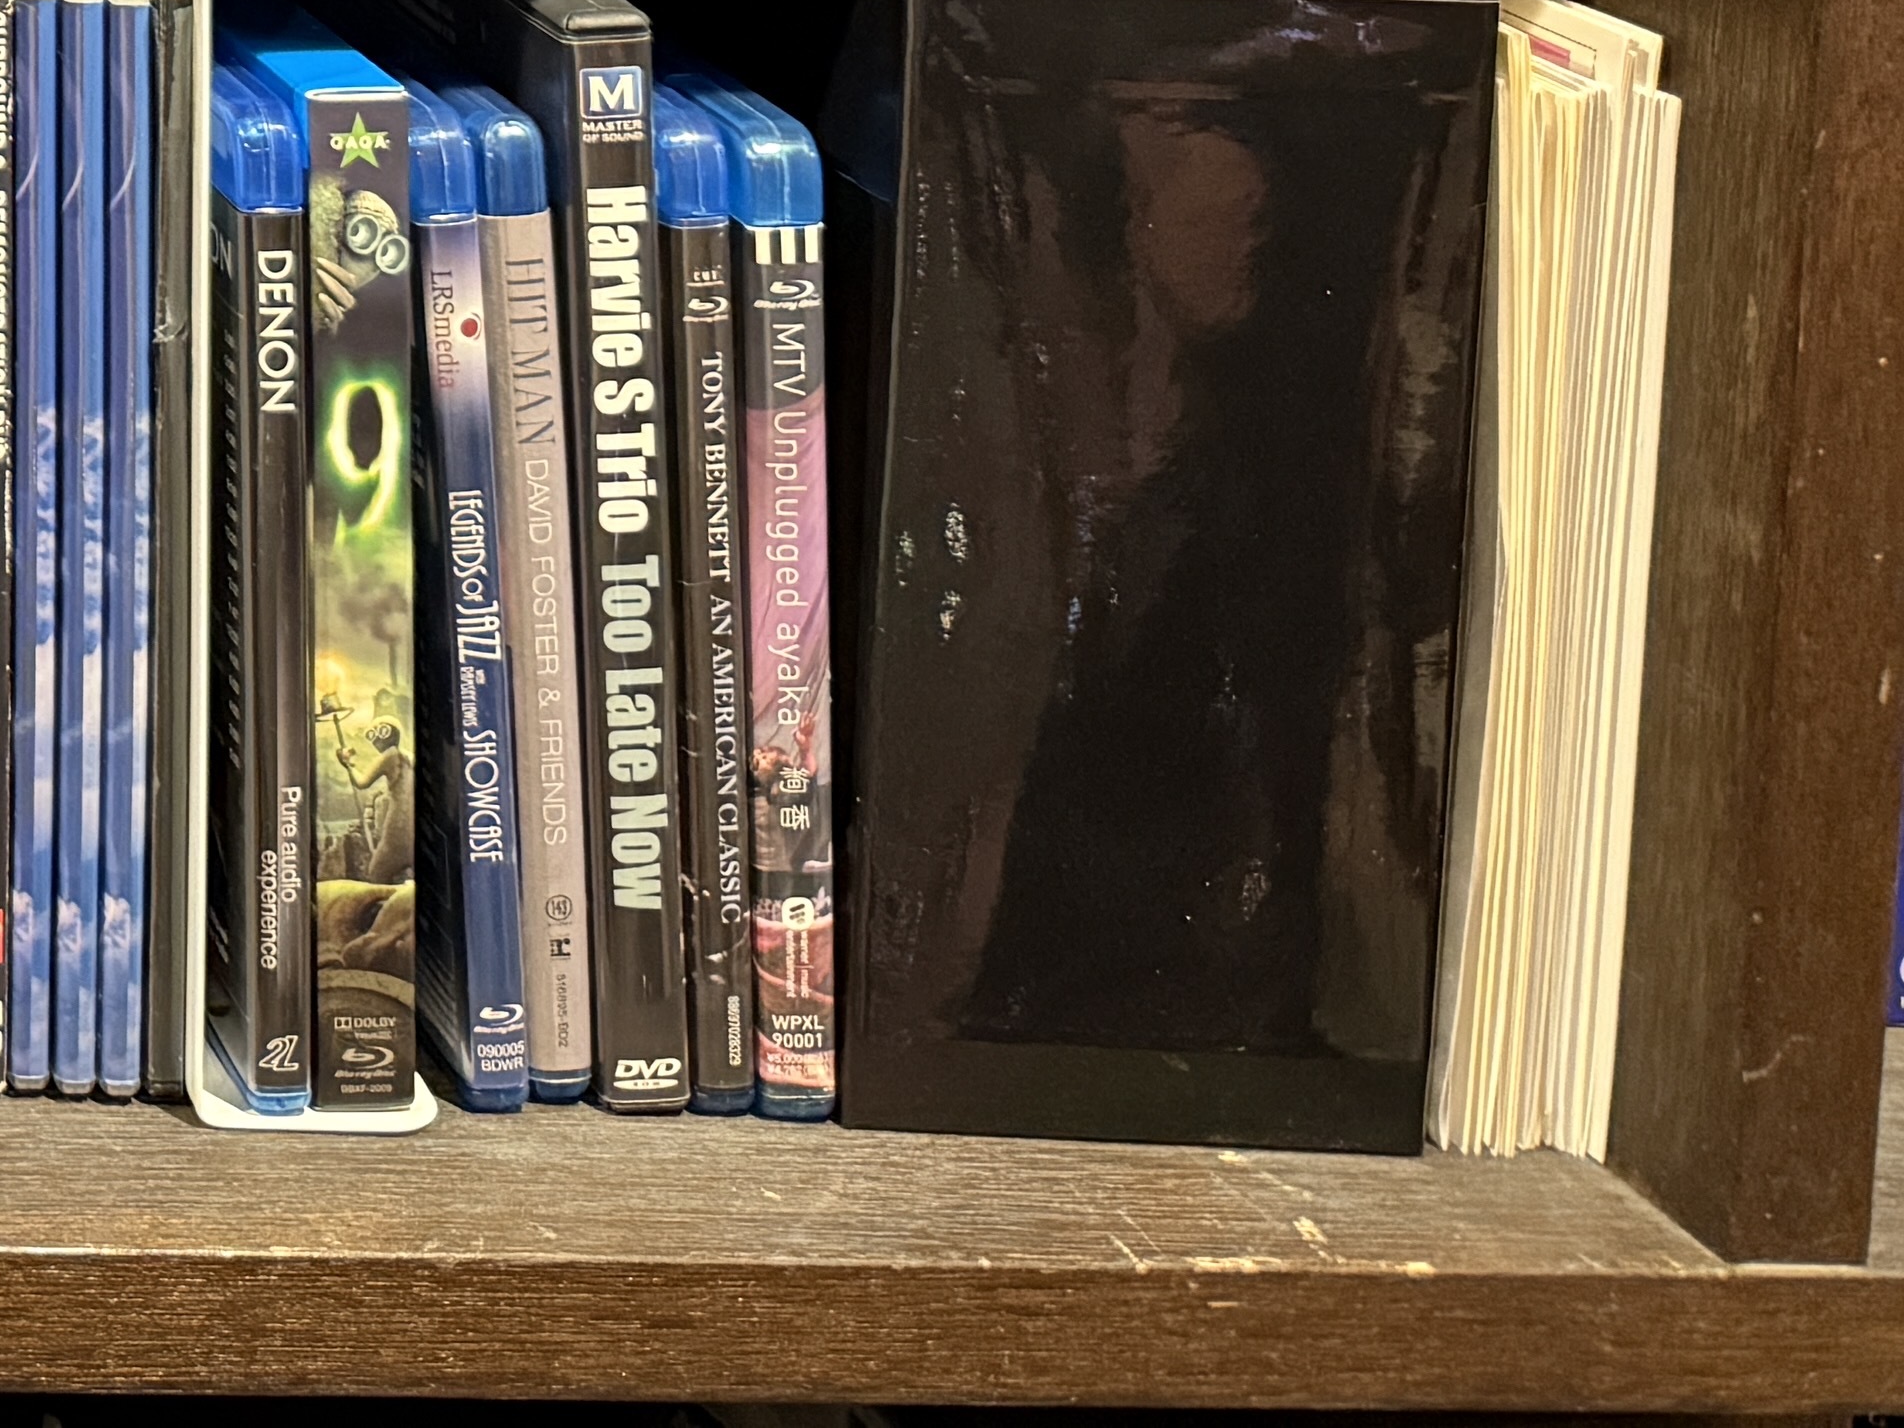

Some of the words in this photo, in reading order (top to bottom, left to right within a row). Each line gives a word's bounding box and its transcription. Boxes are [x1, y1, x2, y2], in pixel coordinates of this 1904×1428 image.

[258, 249, 296, 412] DENON
[431, 269, 460, 390] LRSmedia
[585, 185, 653, 366] Harvie
[594, 378, 654, 415] S
[699, 352, 723, 436] TONY
[771, 323, 806, 395] MTV
[595, 425, 658, 533] Trio
[701, 445, 732, 582] BENNETT
[765, 411, 807, 608] Unplugged
[598, 552, 660, 655] Too
[709, 597, 732, 634] AN
[605, 668, 664, 781] Late
[710, 642, 738, 788] AMERICAN
[769, 620, 801, 728] ayaka
[280, 786, 303, 841] Pure
[464, 729, 504, 863] SHOWCASE
[536, 721, 566, 844] FRIENDS
[279, 842, 299, 906] audio
[608, 795, 668, 910] Now
[718, 804, 742, 925] CLASSIC
[260, 849, 278, 971] experience
[771, 1015, 824, 1031] WPXL
[771, 1033, 824, 1047] 90001
